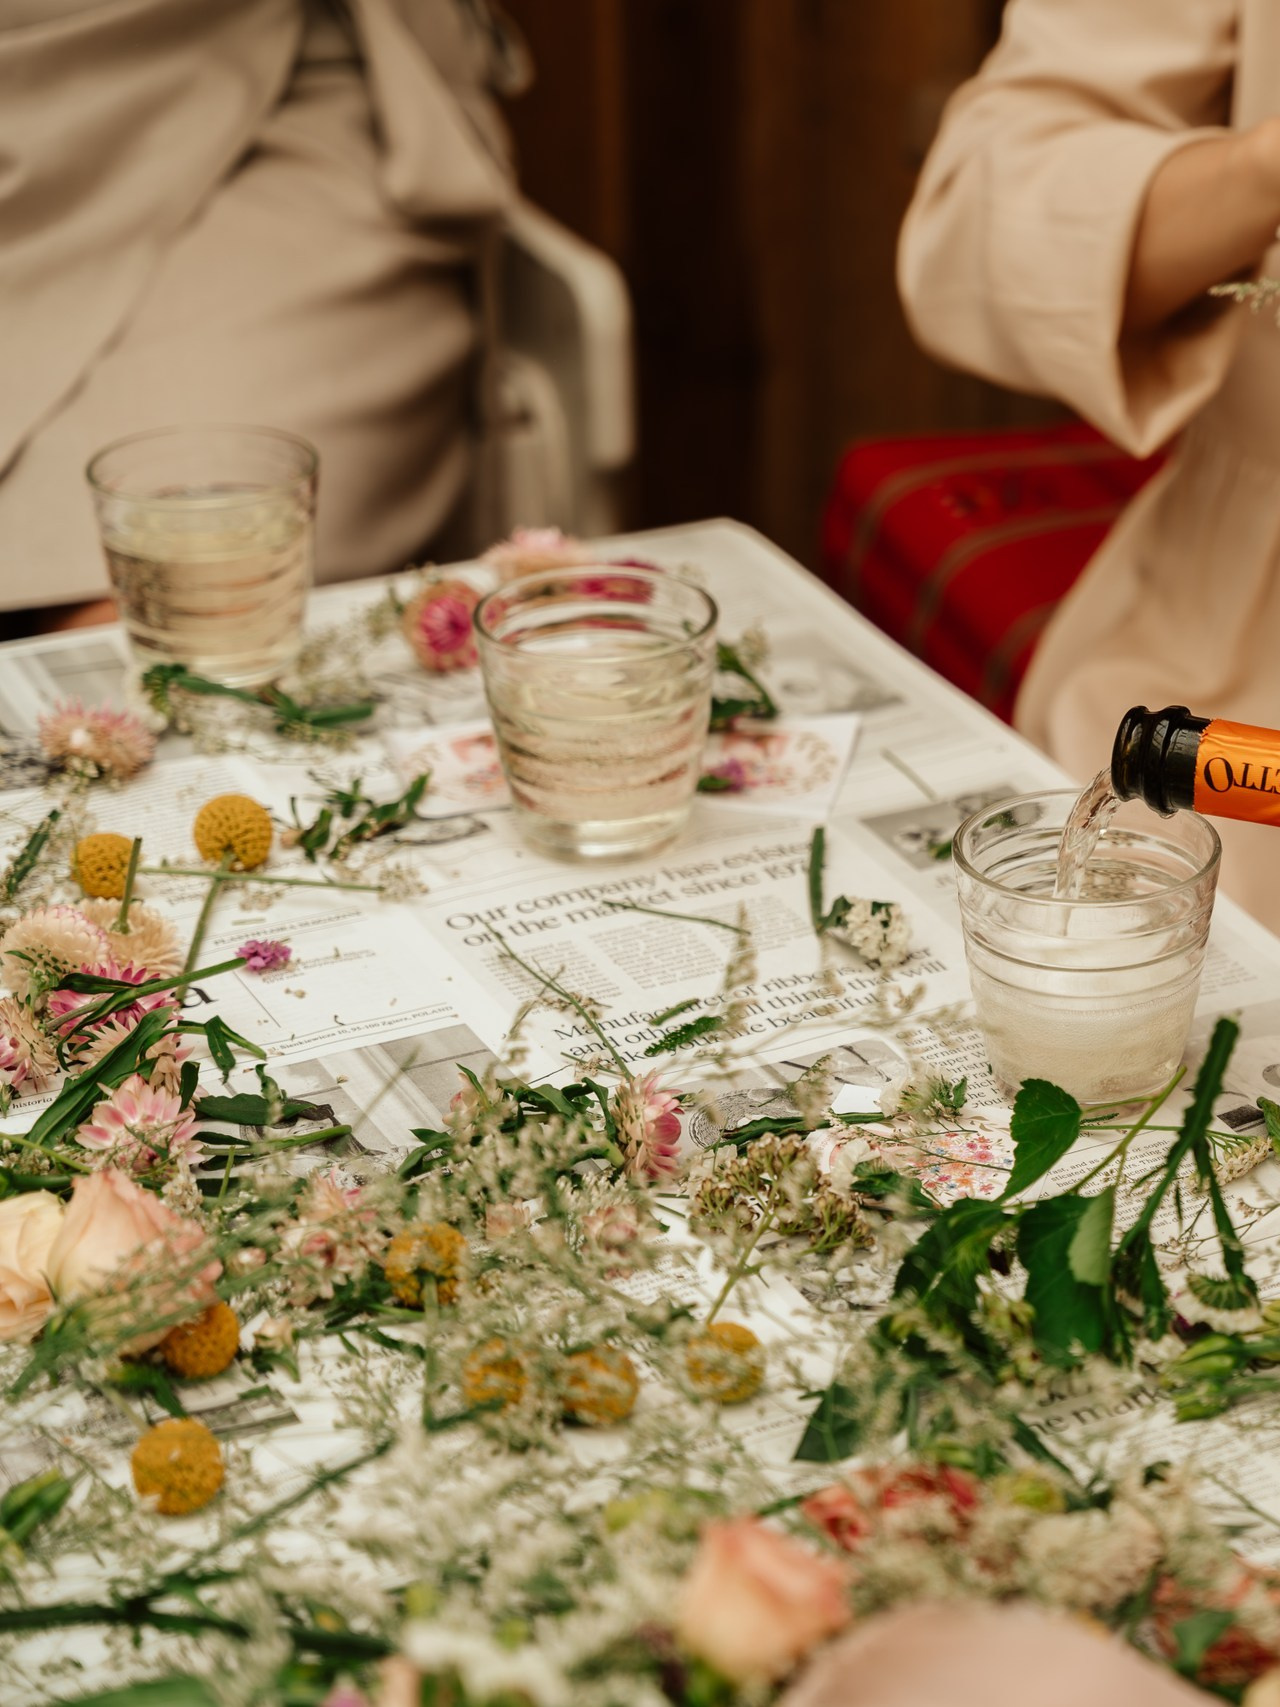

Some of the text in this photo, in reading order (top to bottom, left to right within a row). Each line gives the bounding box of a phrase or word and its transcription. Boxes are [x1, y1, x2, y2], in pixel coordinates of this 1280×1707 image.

[446, 842, 828, 930] Our company has existe
[507, 915, 562, 937] the
[680, 871, 761, 898] since
[762, 964, 863, 993] ribbos,
[412, 1005, 454, 1019] POLAND
[569, 1037, 621, 1057] and
[847, 974, 898, 992] that
[901, 960, 949, 979] will
[12, 1096, 53, 1109] historia
[1070, 1161, 1087, 1170] and
[1143, 1139, 1171, 1151] sophi-
[1050, 1169, 1086, 1182] sticated
